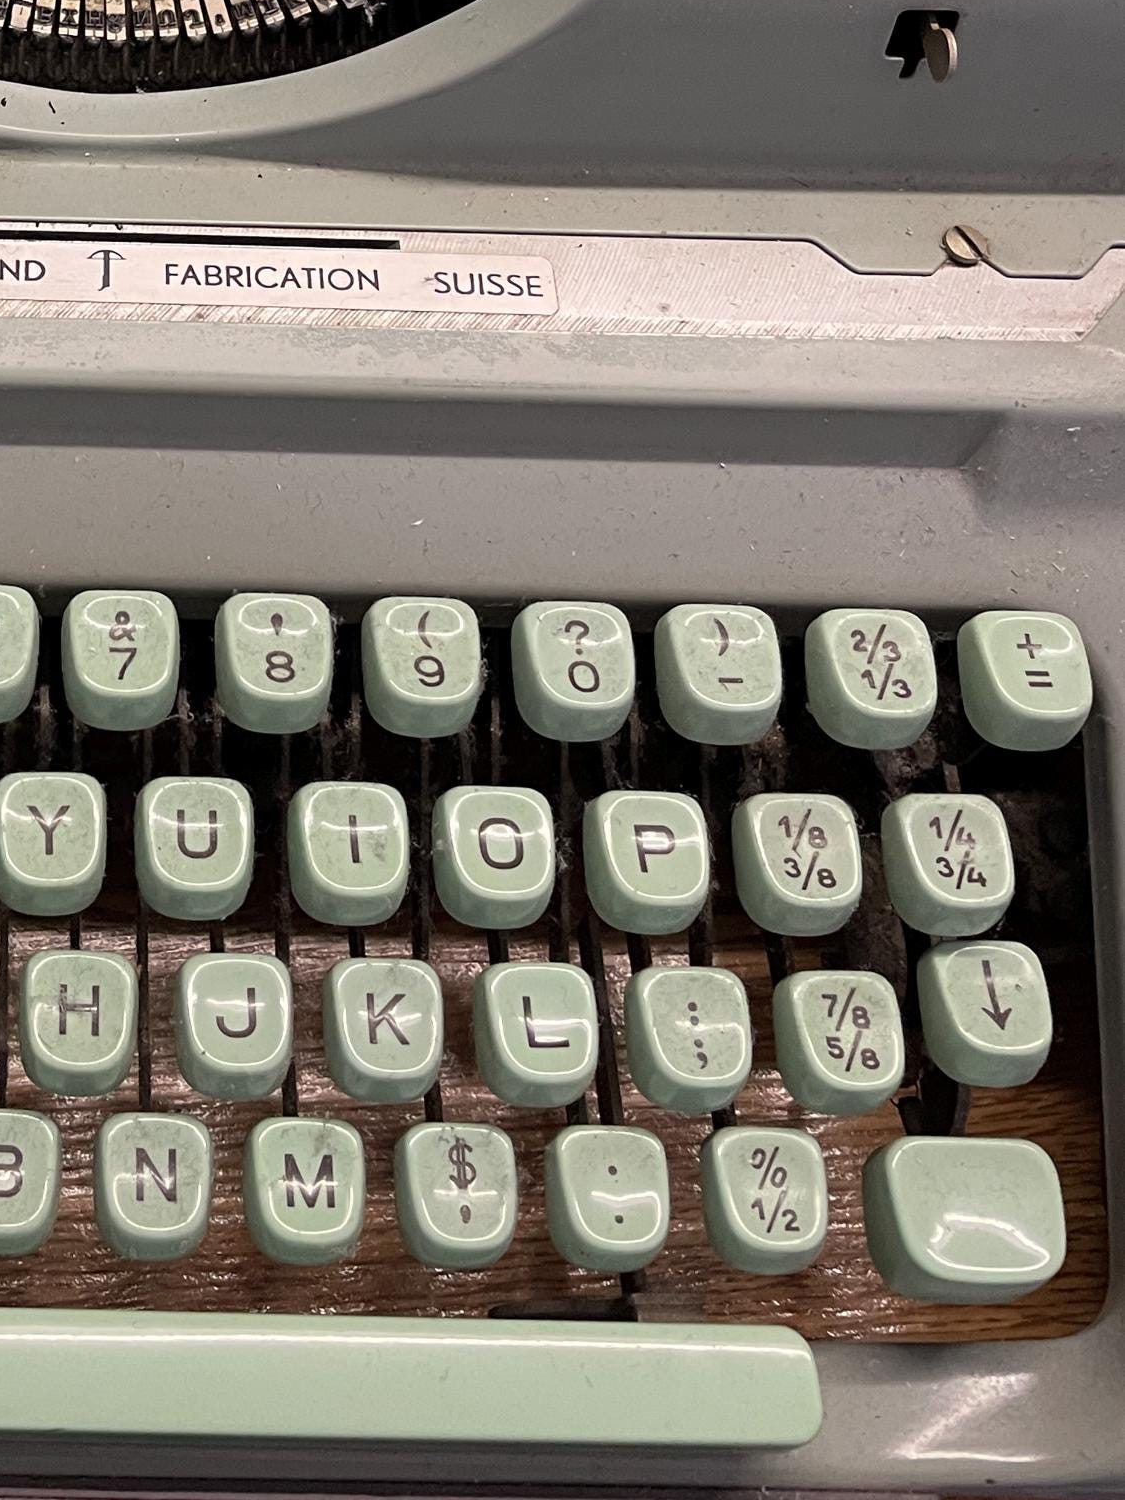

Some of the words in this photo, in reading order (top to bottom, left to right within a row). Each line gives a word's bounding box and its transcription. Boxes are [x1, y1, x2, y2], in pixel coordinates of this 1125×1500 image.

[166, 264, 379, 291] FABRICATION
[434, 272, 543, 297] SUISSE
[109, 611, 136, 641] &
[418, 611, 432, 648] (
[565, 620, 589, 655] ?
[714, 618, 728, 656] )
[1017, 634, 1041, 659] +
[109, 648, 137, 680] 7
[266, 651, 295, 683] 8
[414, 656, 444, 687] 9
[568, 661, 599, 692] 0
[1025, 671, 1053, 687] =
[27, 805, 70, 855] Y
[177, 810, 217, 859] U
[349, 815, 361, 863] I
[479, 818, 523, 869] O
[634, 825, 674, 873] P
[59, 984, 99, 1036] H
[216, 988, 256, 1038] J
[366, 993, 410, 1045] K
[523, 996, 570, 1048] L
[136, 1148, 177, 1203] N
[285, 1154, 335, 1208] M
[448, 1136, 476, 1189] $
